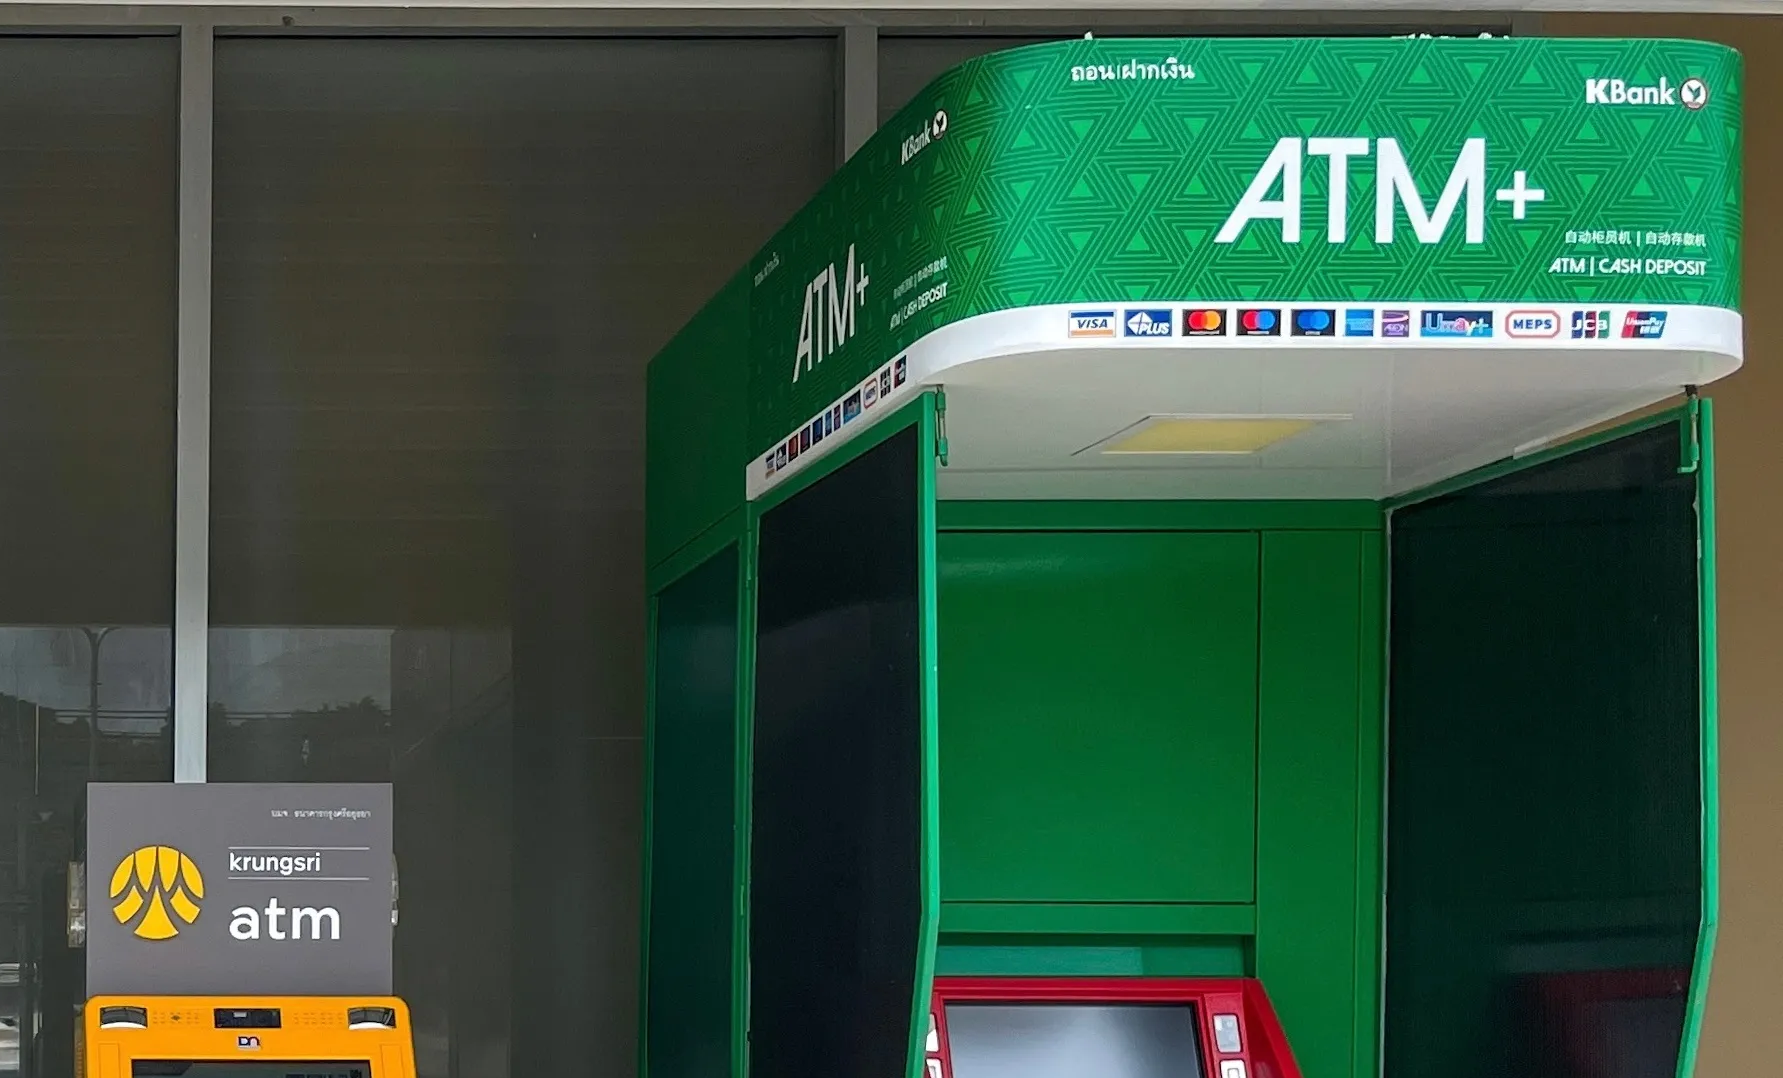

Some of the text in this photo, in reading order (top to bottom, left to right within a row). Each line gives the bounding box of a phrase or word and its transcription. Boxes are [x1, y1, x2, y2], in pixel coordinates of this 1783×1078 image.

[1585, 77, 1676, 105] KBank
[900, 122, 932, 165] KBank
[1213, 136, 1546, 245] ATM+
[1548, 257, 1707, 276] ATM CASH DEPOSIT
[792, 243, 870, 384] ATM+
[1075, 318, 1170, 335] VISA PLUS
[1512, 318, 1609, 332] MEPS JCB
[229, 852, 321, 876] krungsri
[228, 898, 341, 940] atm
